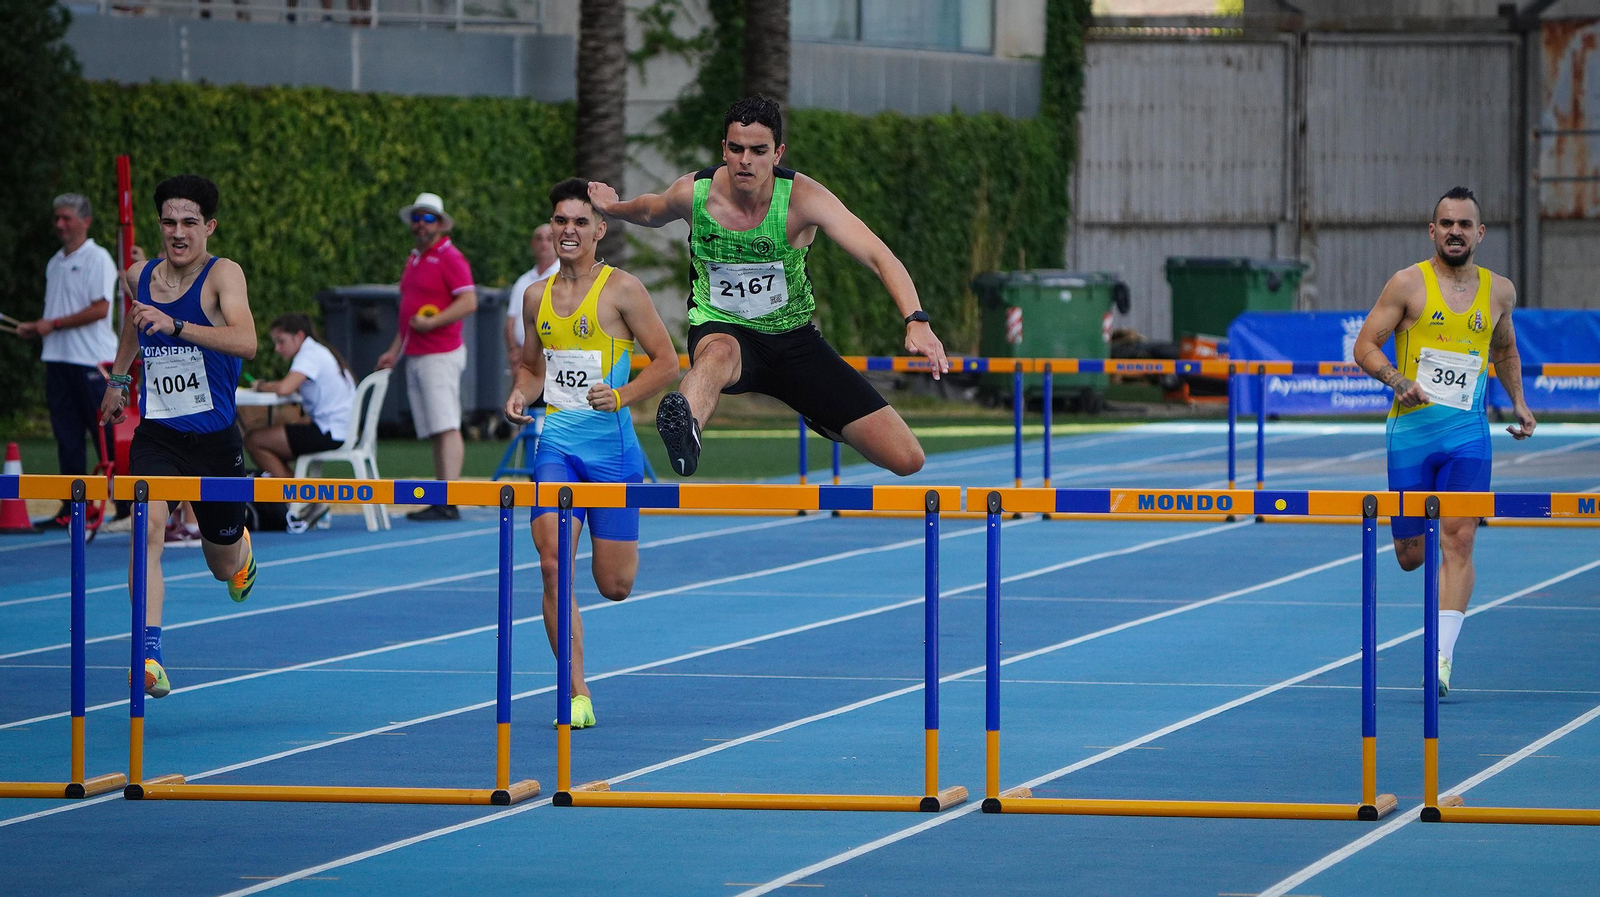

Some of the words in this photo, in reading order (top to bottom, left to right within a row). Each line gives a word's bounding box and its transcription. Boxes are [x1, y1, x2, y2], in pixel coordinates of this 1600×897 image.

[719, 274, 775, 298] 2167
[153, 372, 200, 395] 1004
[555, 370, 588, 388] 452
[1268, 376, 1384, 397] Ayuntamiento
[1432, 368, 1467, 389] 394
[1331, 392, 1388, 407] Deportes
[282, 484, 373, 501] MONDO
[1138, 494, 1233, 511] MONDO
[1578, 498, 1600, 514] M
